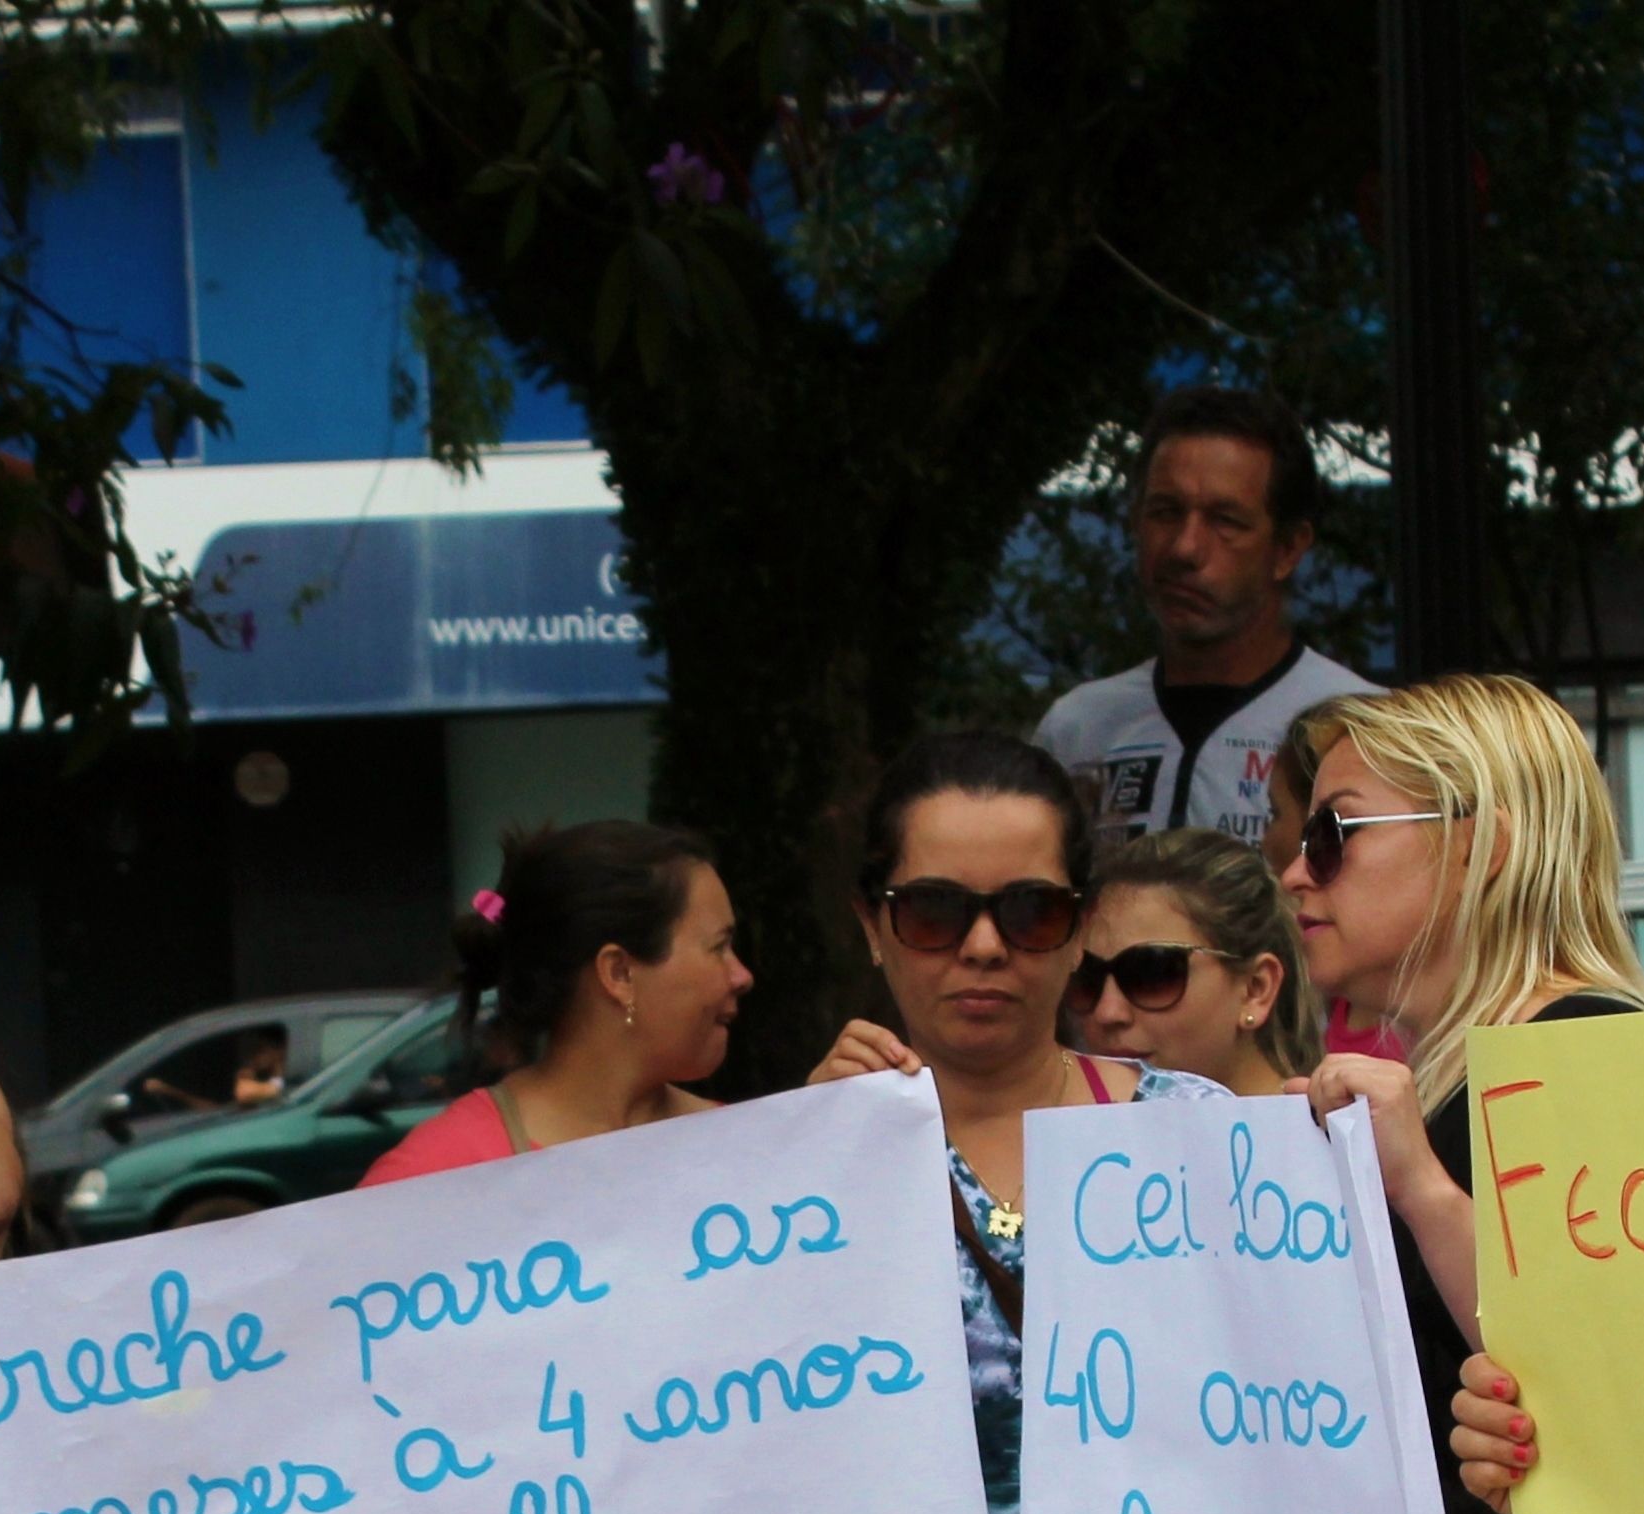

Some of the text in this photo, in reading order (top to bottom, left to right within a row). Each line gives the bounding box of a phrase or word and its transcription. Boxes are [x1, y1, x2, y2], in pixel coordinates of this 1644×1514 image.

[429, 605, 648, 646] www.unice.
[1075, 1153, 1204, 1264] Cei
[330, 1241, 611, 1382] para
[539, 1362, 585, 1458] 4
[624, 1336, 924, 1443] anos
[1044, 1324, 1366, 1449] 40 anos
